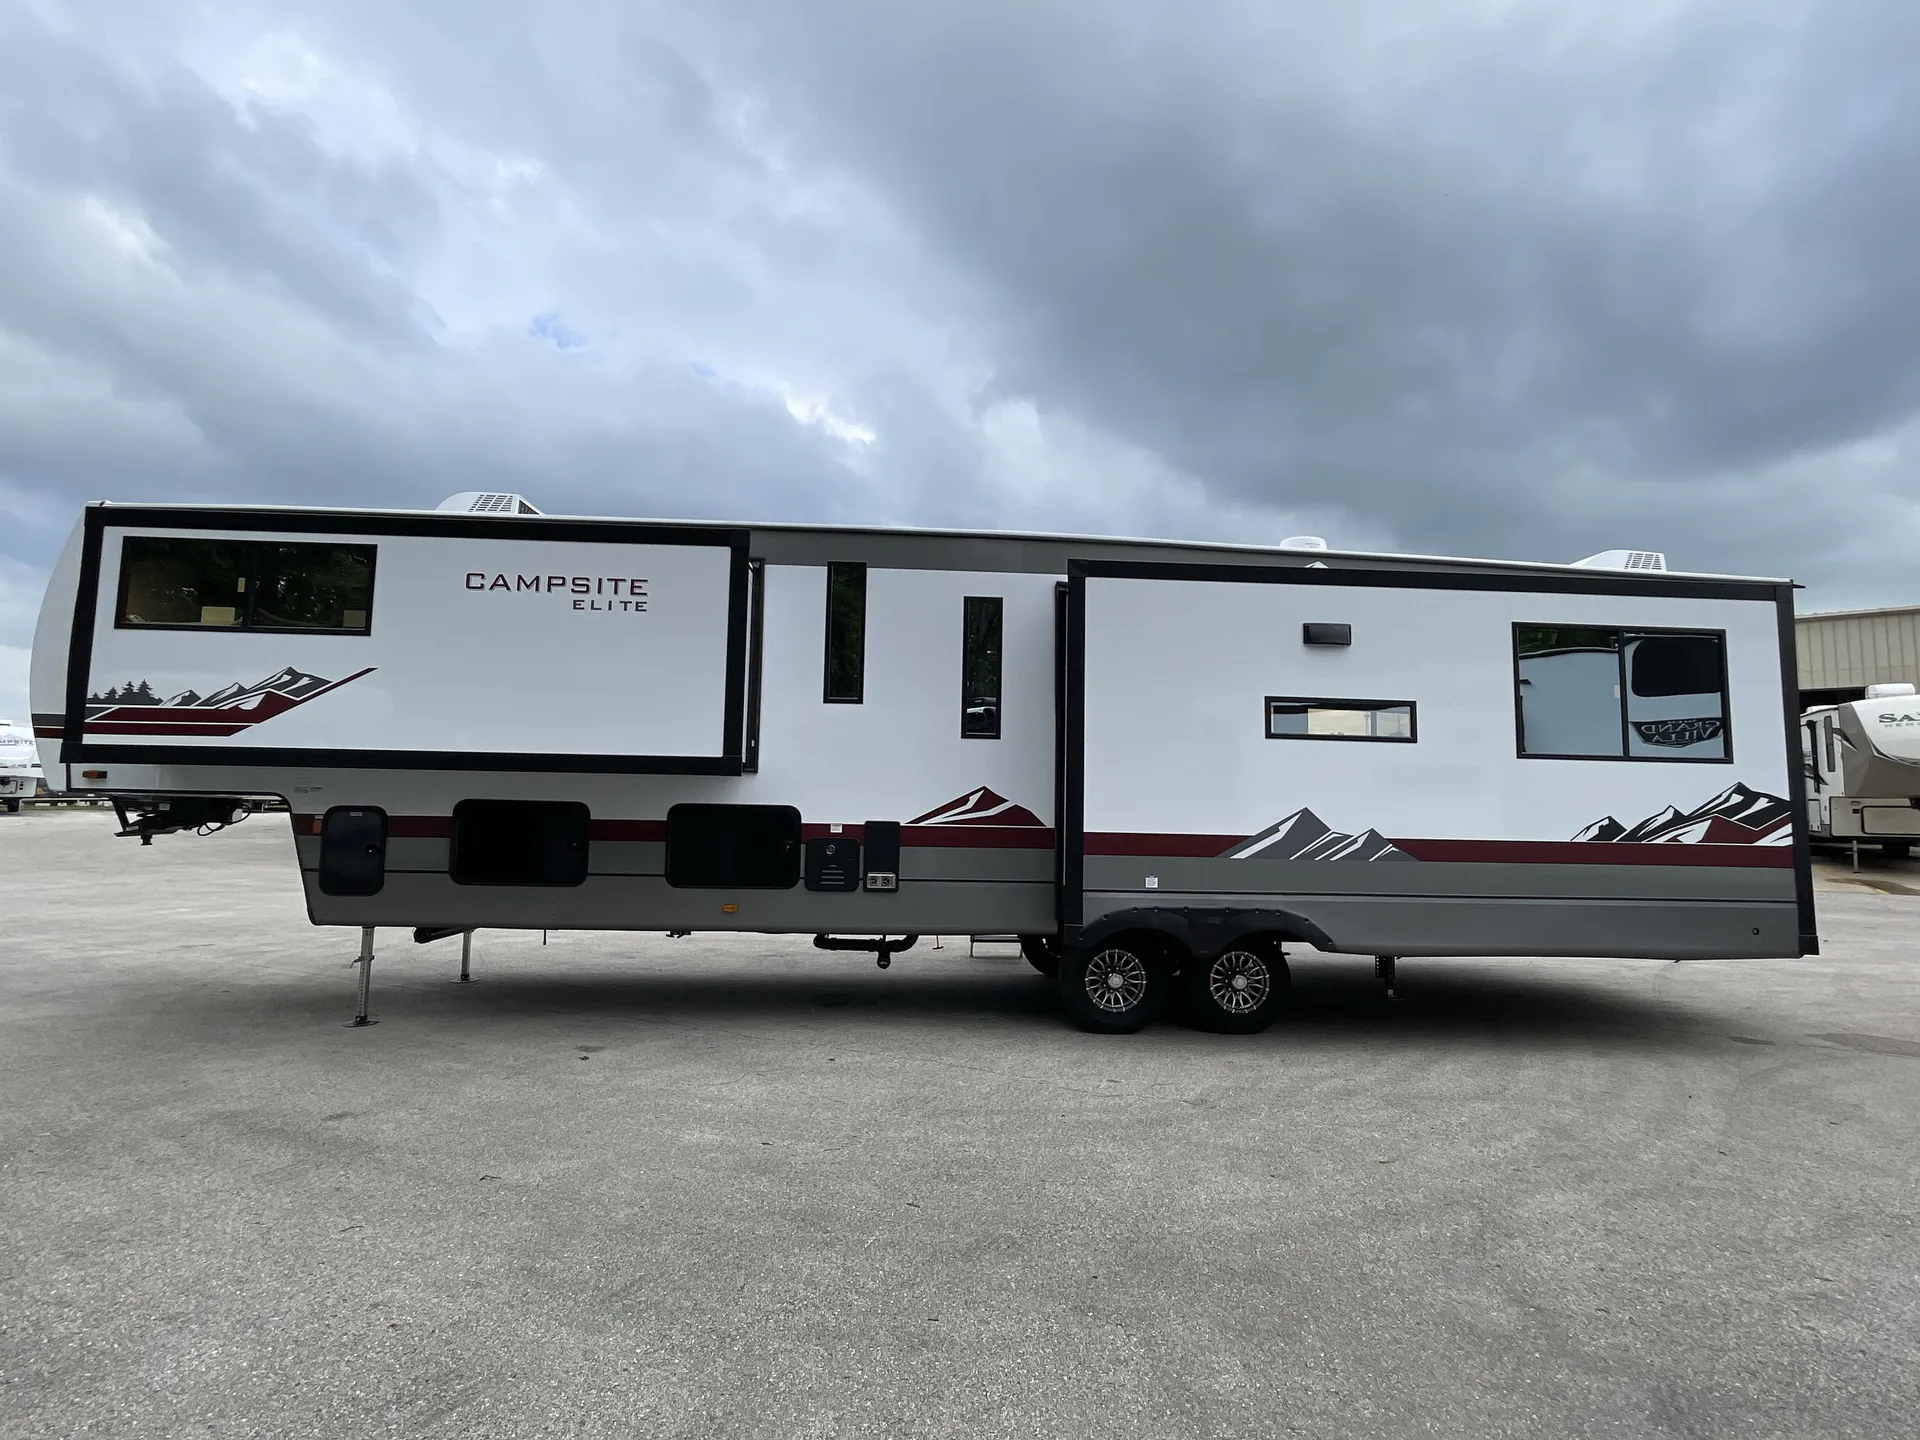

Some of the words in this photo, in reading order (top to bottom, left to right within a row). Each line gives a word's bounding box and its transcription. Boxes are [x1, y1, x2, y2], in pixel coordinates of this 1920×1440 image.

[465, 573, 649, 597] CAMPSITE
[572, 599, 648, 613] ELITE
[1878, 712, 1920, 724] SA
